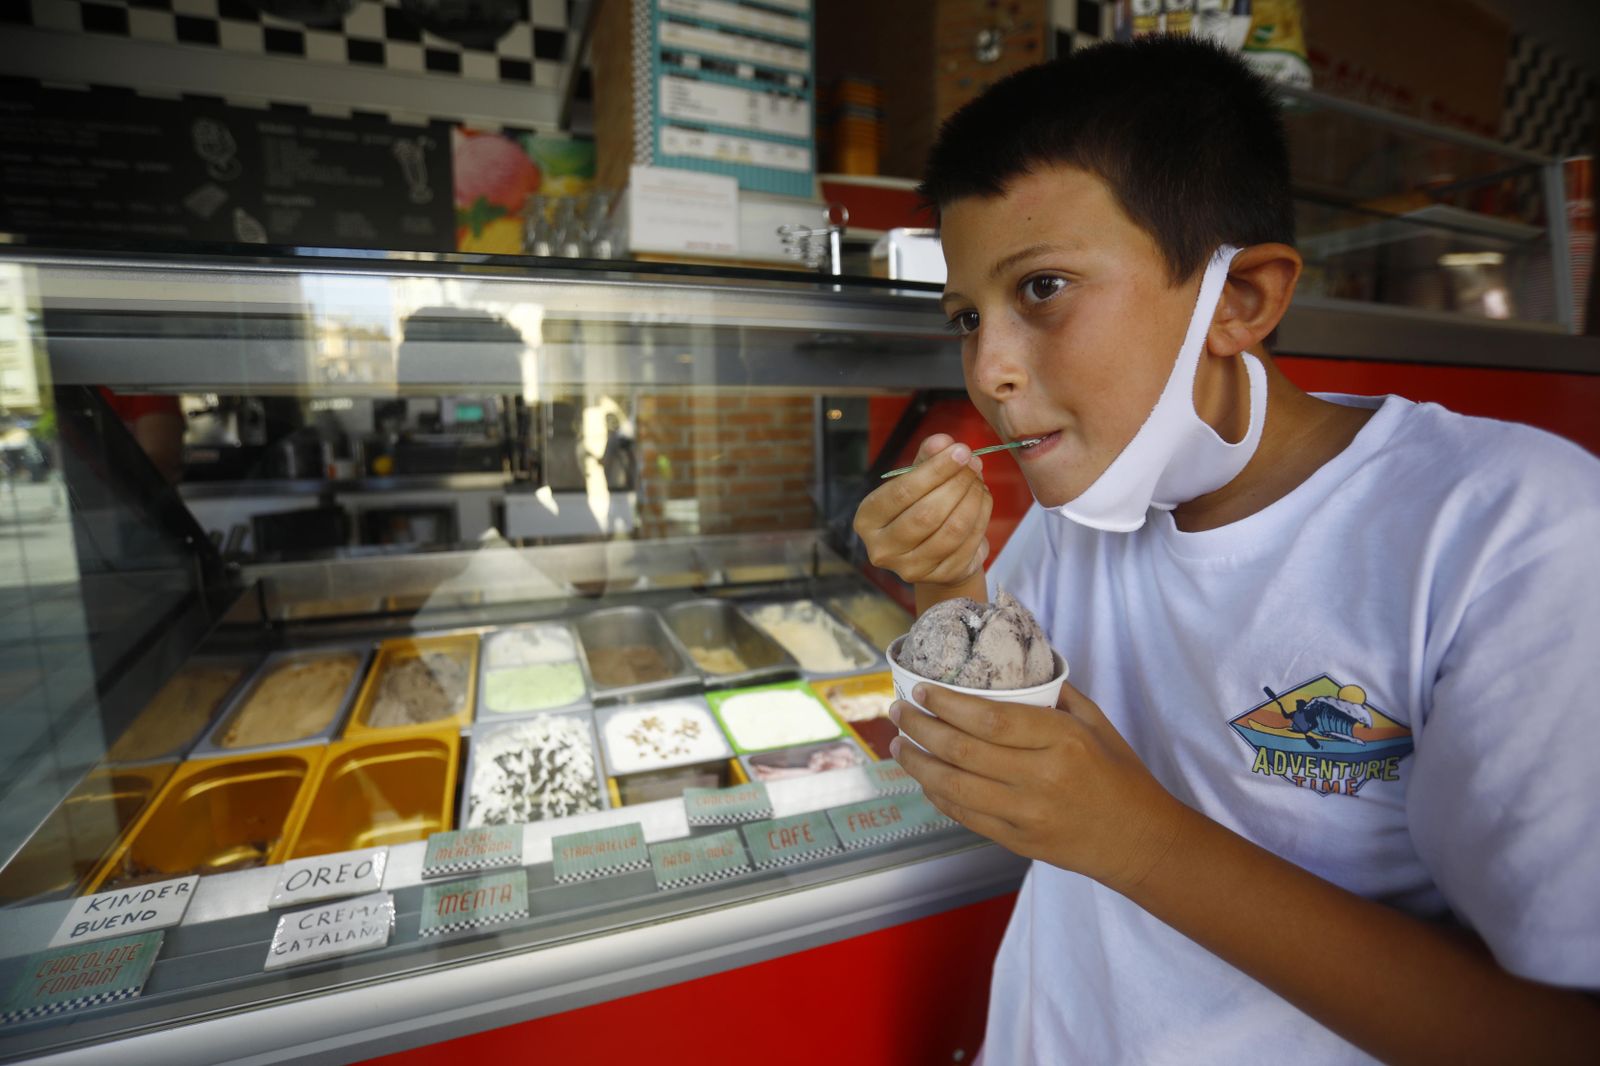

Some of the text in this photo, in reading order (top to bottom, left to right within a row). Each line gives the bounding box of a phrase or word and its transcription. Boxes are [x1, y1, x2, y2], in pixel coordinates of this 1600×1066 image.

[1251, 746, 1401, 782] ADVENTURE
[1292, 775, 1359, 797] TIME
[846, 803, 903, 833] FRESA
[285, 860, 373, 892] OREO
[84, 882, 190, 914] KINDER
[437, 882, 513, 917] MENTA
[70, 909, 157, 938] BUENO
[35, 943, 144, 978] CHOCOLATE
[34, 965, 123, 996] FONDANT
